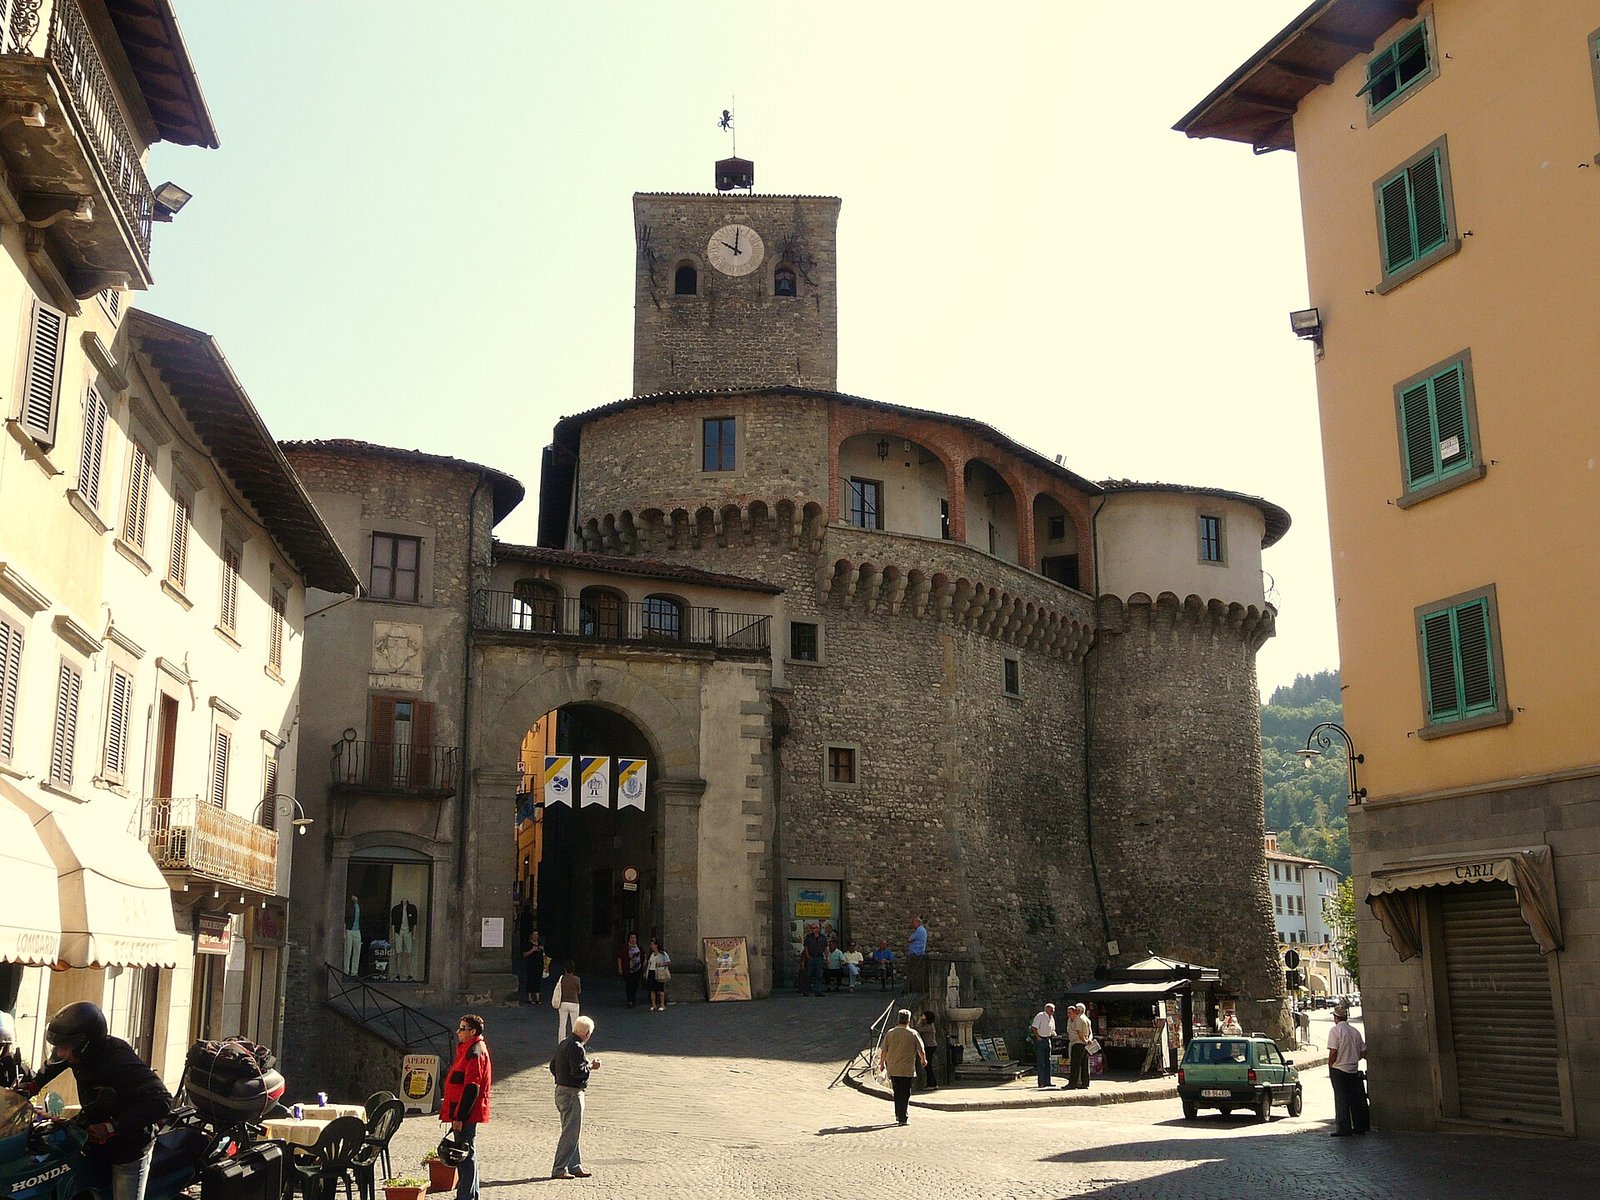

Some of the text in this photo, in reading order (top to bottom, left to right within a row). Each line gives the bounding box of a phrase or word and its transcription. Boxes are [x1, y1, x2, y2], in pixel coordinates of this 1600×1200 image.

[1455, 863, 1494, 879] CARLI
[374, 948, 395, 956] saldi
[406, 1057, 436, 1065] APERTO
[11, 1163, 72, 1193] HONDA
